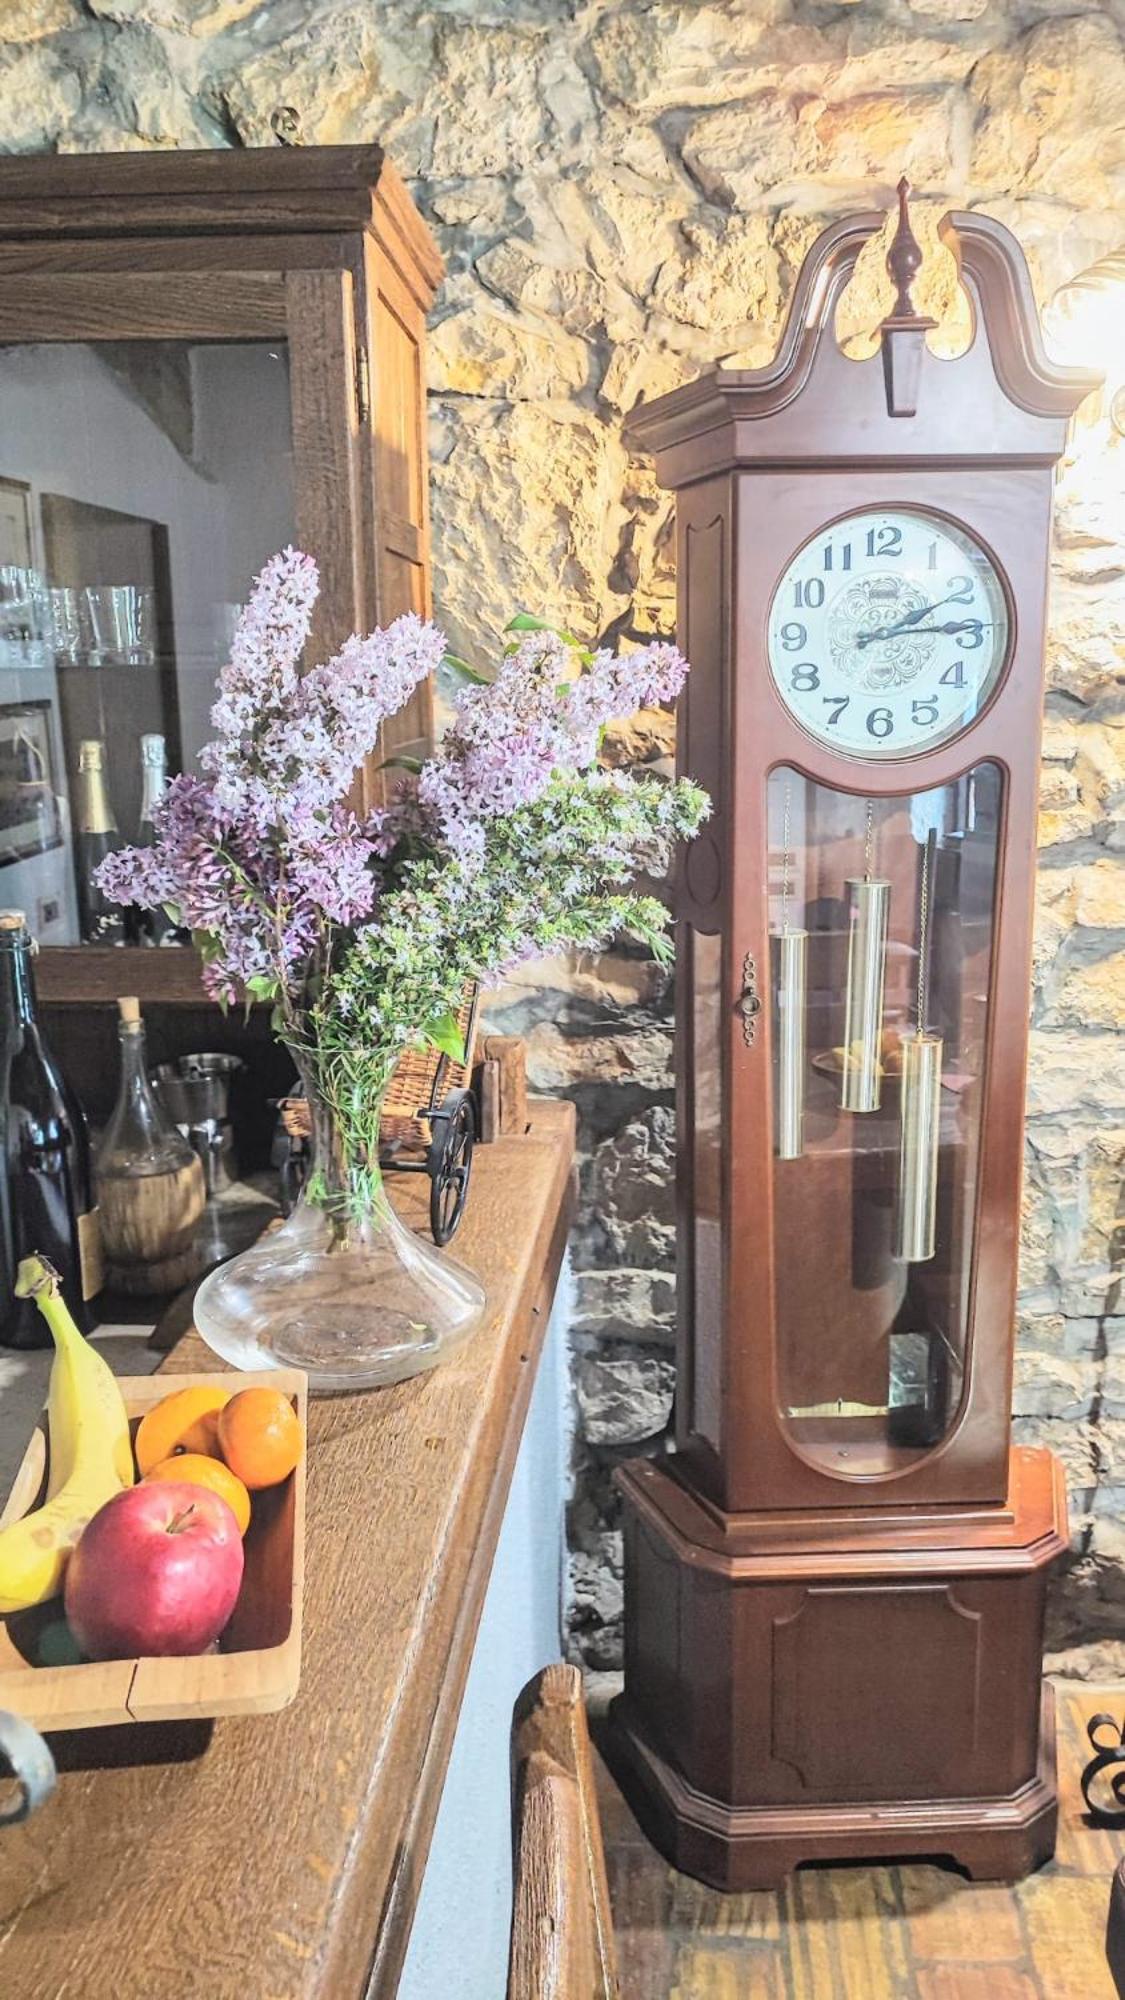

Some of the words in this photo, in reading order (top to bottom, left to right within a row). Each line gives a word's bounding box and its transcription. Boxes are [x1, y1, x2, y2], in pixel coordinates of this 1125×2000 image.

[865, 527, 902, 556] 12
[928, 542, 938, 570] 1
[823, 543, 852, 571] 11
[794, 577, 825, 608] 10
[947, 575, 975, 604] 2
[780, 622, 807, 651] 9
[955, 618, 984, 649] 3
[791, 663, 820, 692] 8
[938, 661, 968, 688] 4
[822, 695, 850, 724] 7
[866, 708, 894, 737] 6
[911, 694, 939, 725] 5
